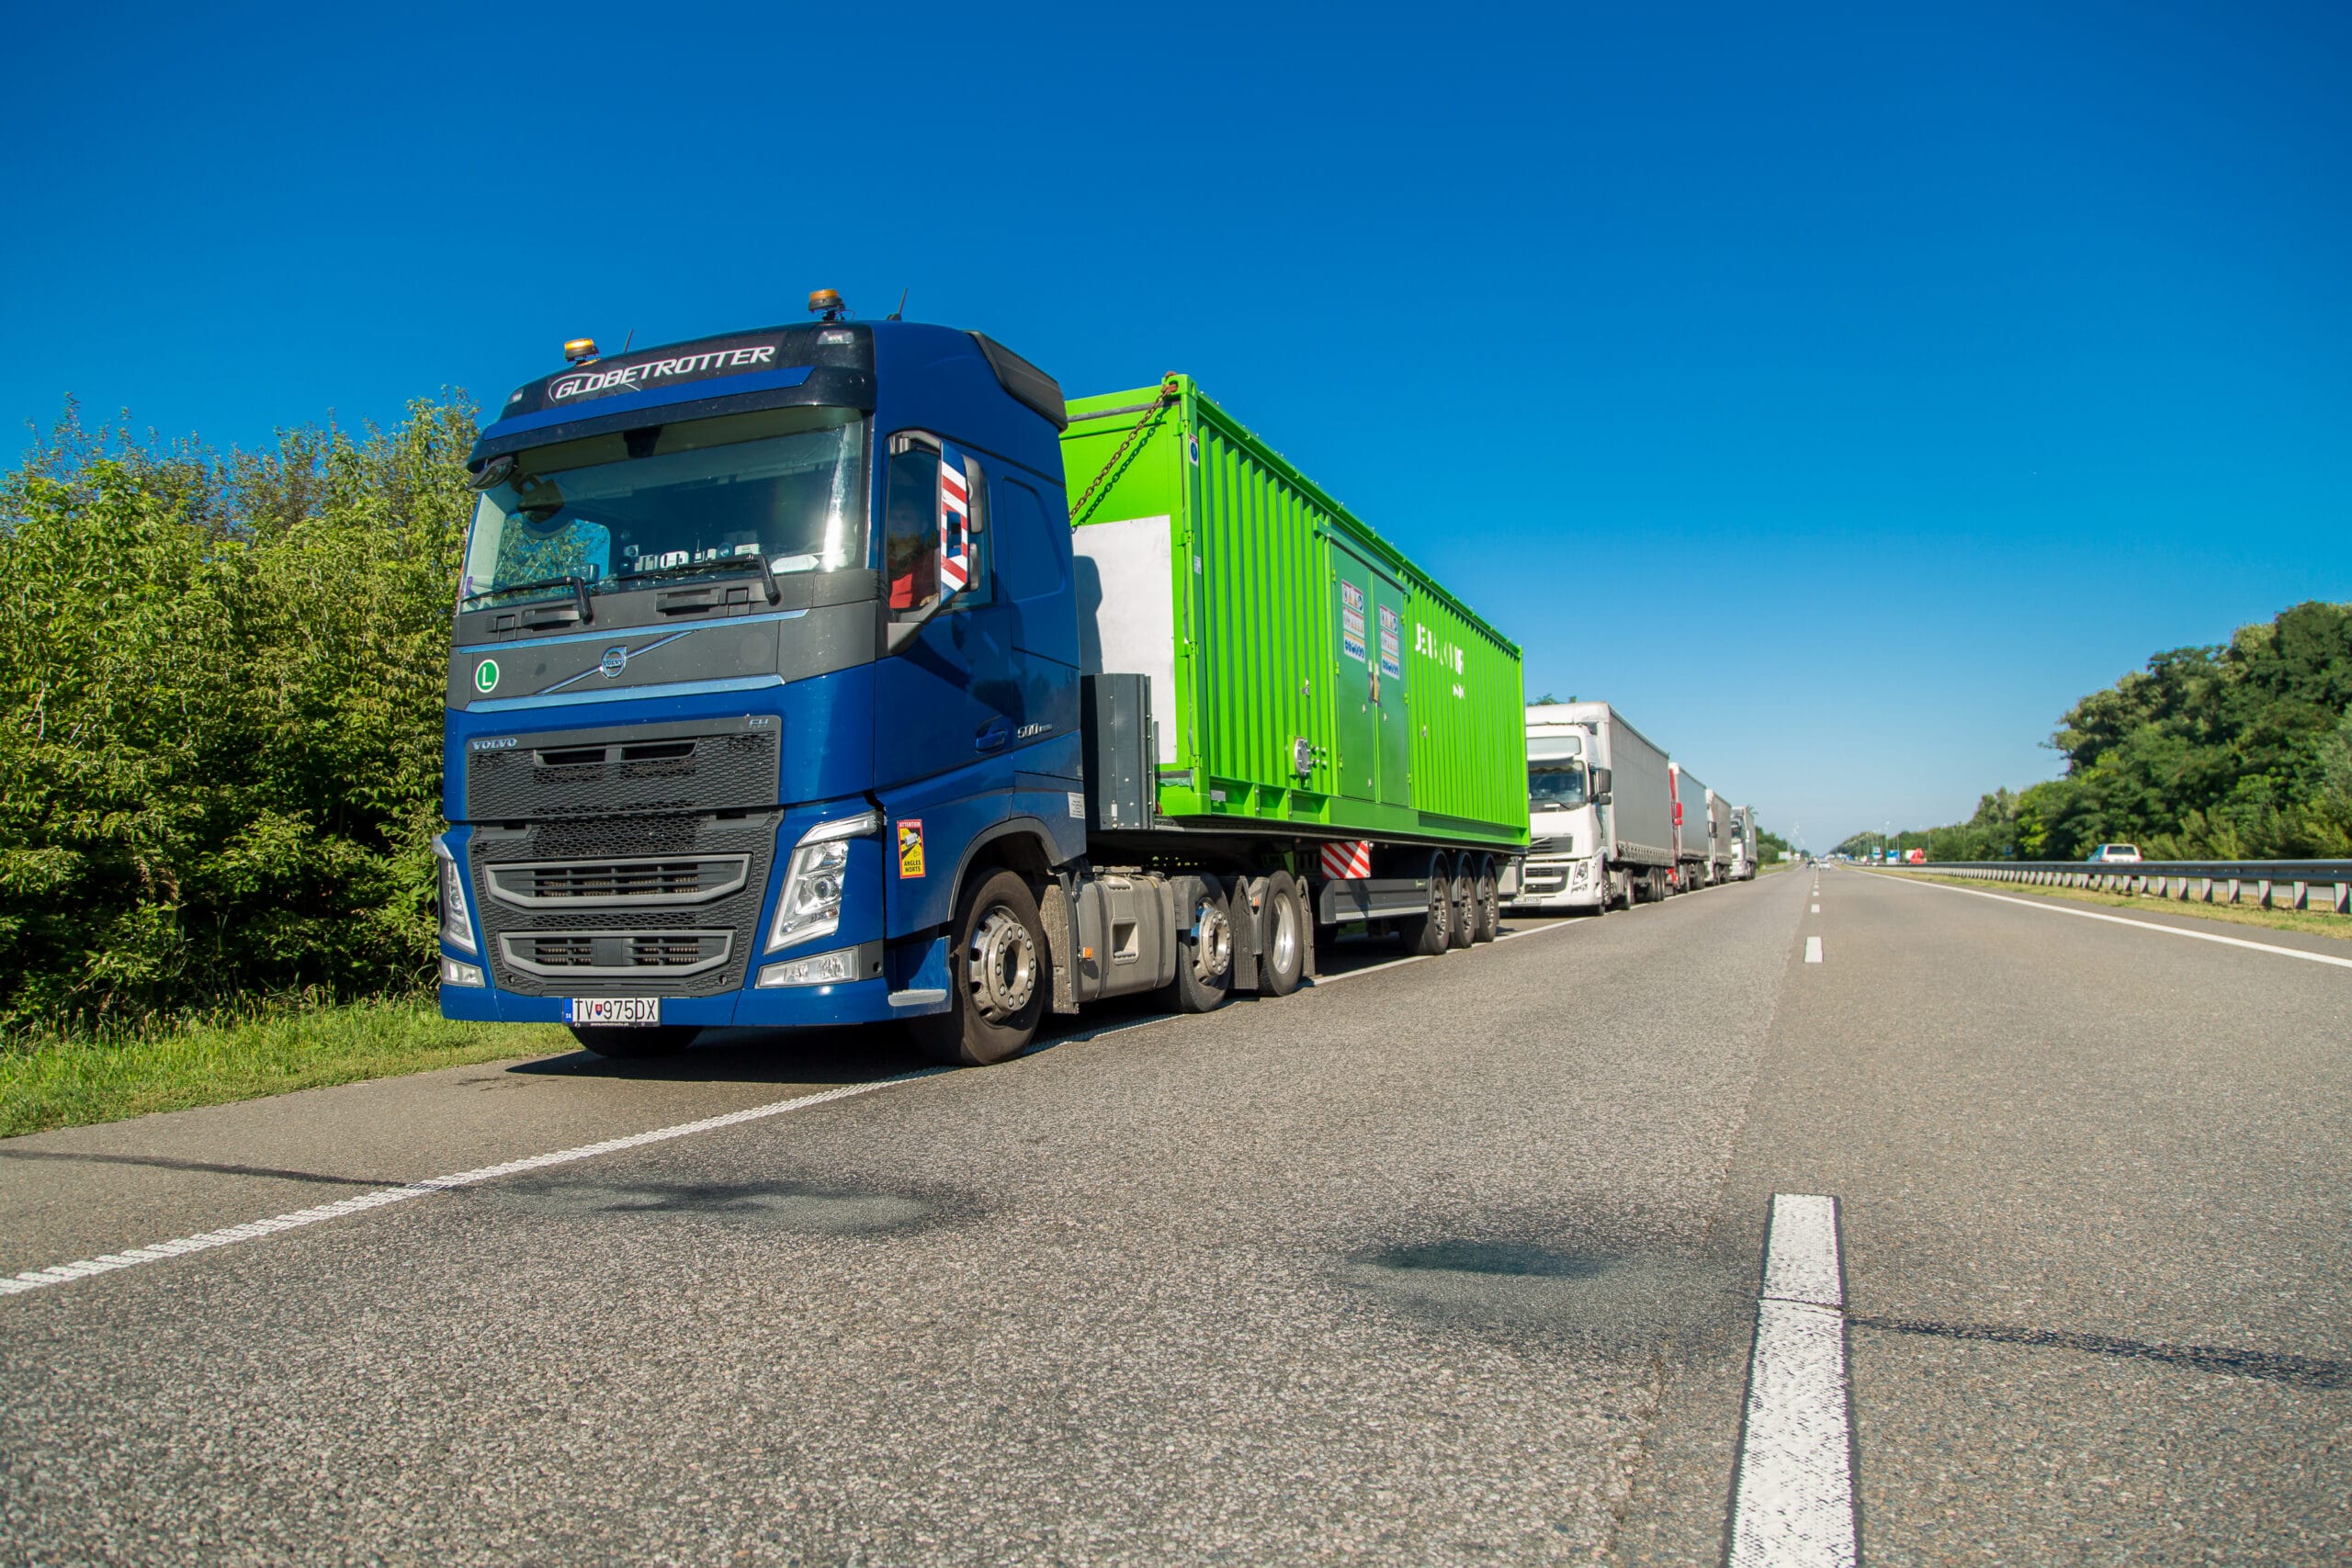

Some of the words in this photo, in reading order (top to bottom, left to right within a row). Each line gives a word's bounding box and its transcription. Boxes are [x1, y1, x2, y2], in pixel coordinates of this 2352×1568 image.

[555, 345, 775, 400] GLOBETROTTER
[481, 666, 492, 686] L
[749, 718, 769, 729] FH
[471, 738, 517, 750] VOLVO
